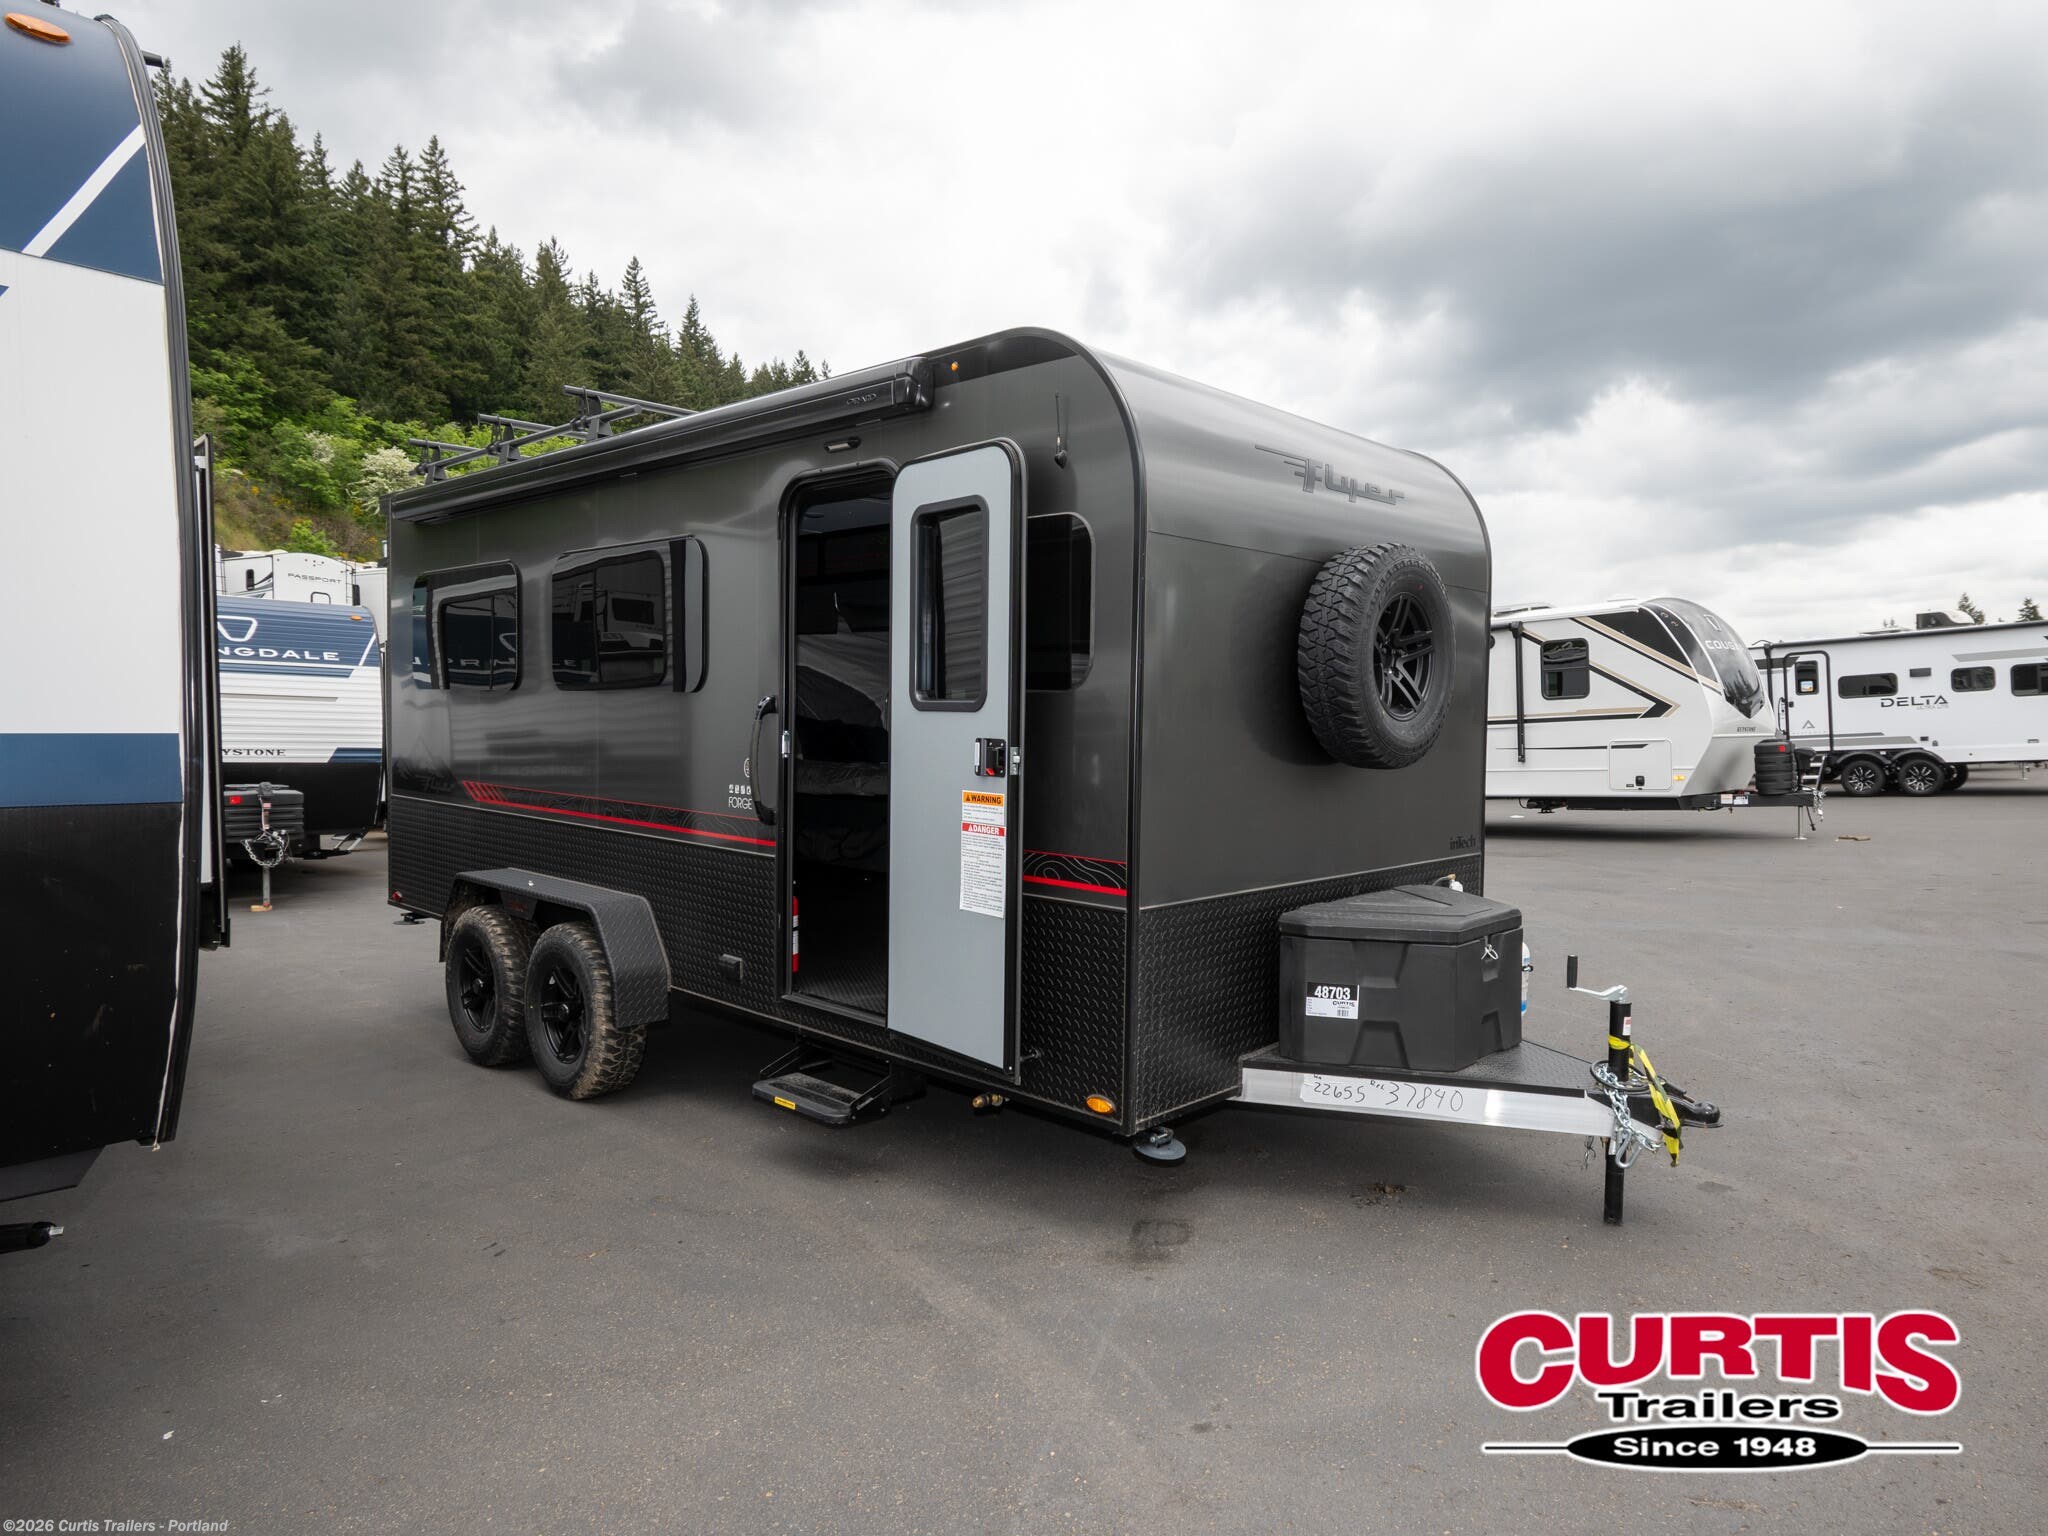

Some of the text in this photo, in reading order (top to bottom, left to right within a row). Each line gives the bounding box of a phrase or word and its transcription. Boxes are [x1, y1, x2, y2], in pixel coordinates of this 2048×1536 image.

[1255, 444, 1405, 506] Flyer
[288, 573, 342, 584] PASSPORT
[1705, 640, 1739, 650] COUG
[1881, 695, 1949, 708] DELTA
[728, 796, 753, 810] FORGE
[971, 794, 1002, 804] WARNING
[972, 824, 1000, 835] DANGER
[1314, 985, 1351, 1000] 48703
[1313, 1081, 1464, 1112] 22655 37840
